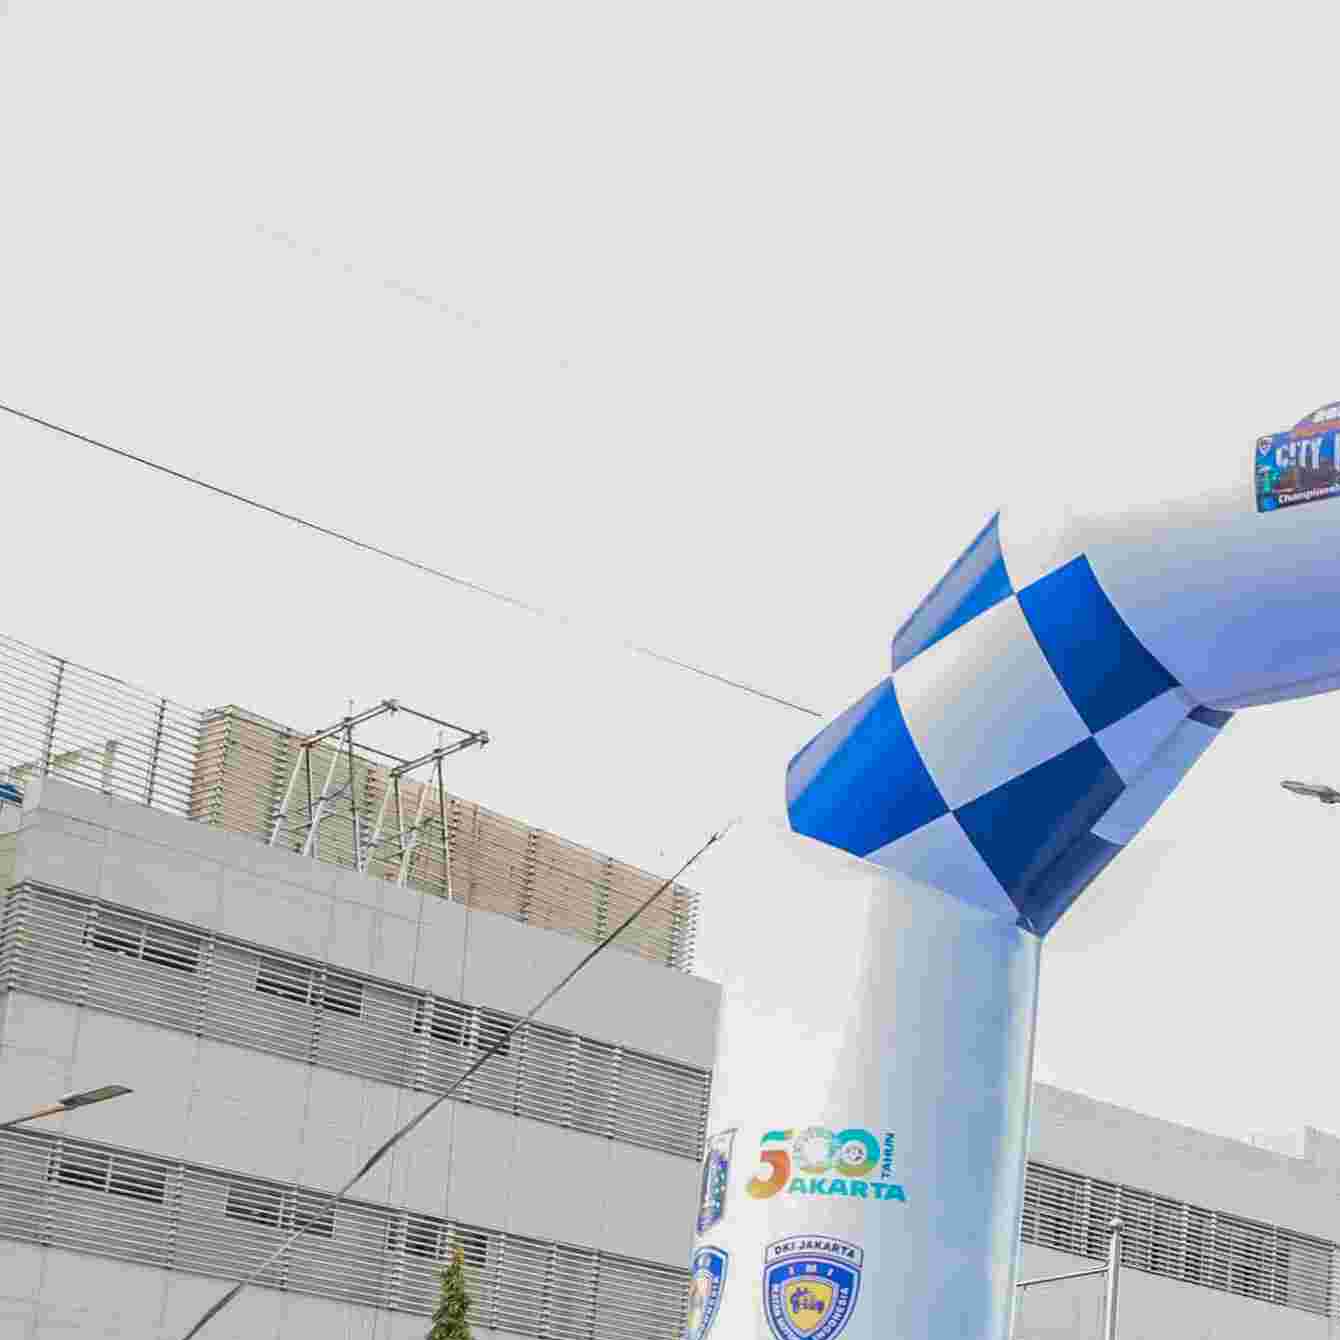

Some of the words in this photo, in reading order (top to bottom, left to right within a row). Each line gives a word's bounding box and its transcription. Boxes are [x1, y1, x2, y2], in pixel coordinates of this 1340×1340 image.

[1276, 437, 1323, 467] CITY
[881, 1132, 895, 1180] TAHUN
[775, 1242, 794, 1255] DKI
[800, 1240, 855, 1258] JAKARTA
